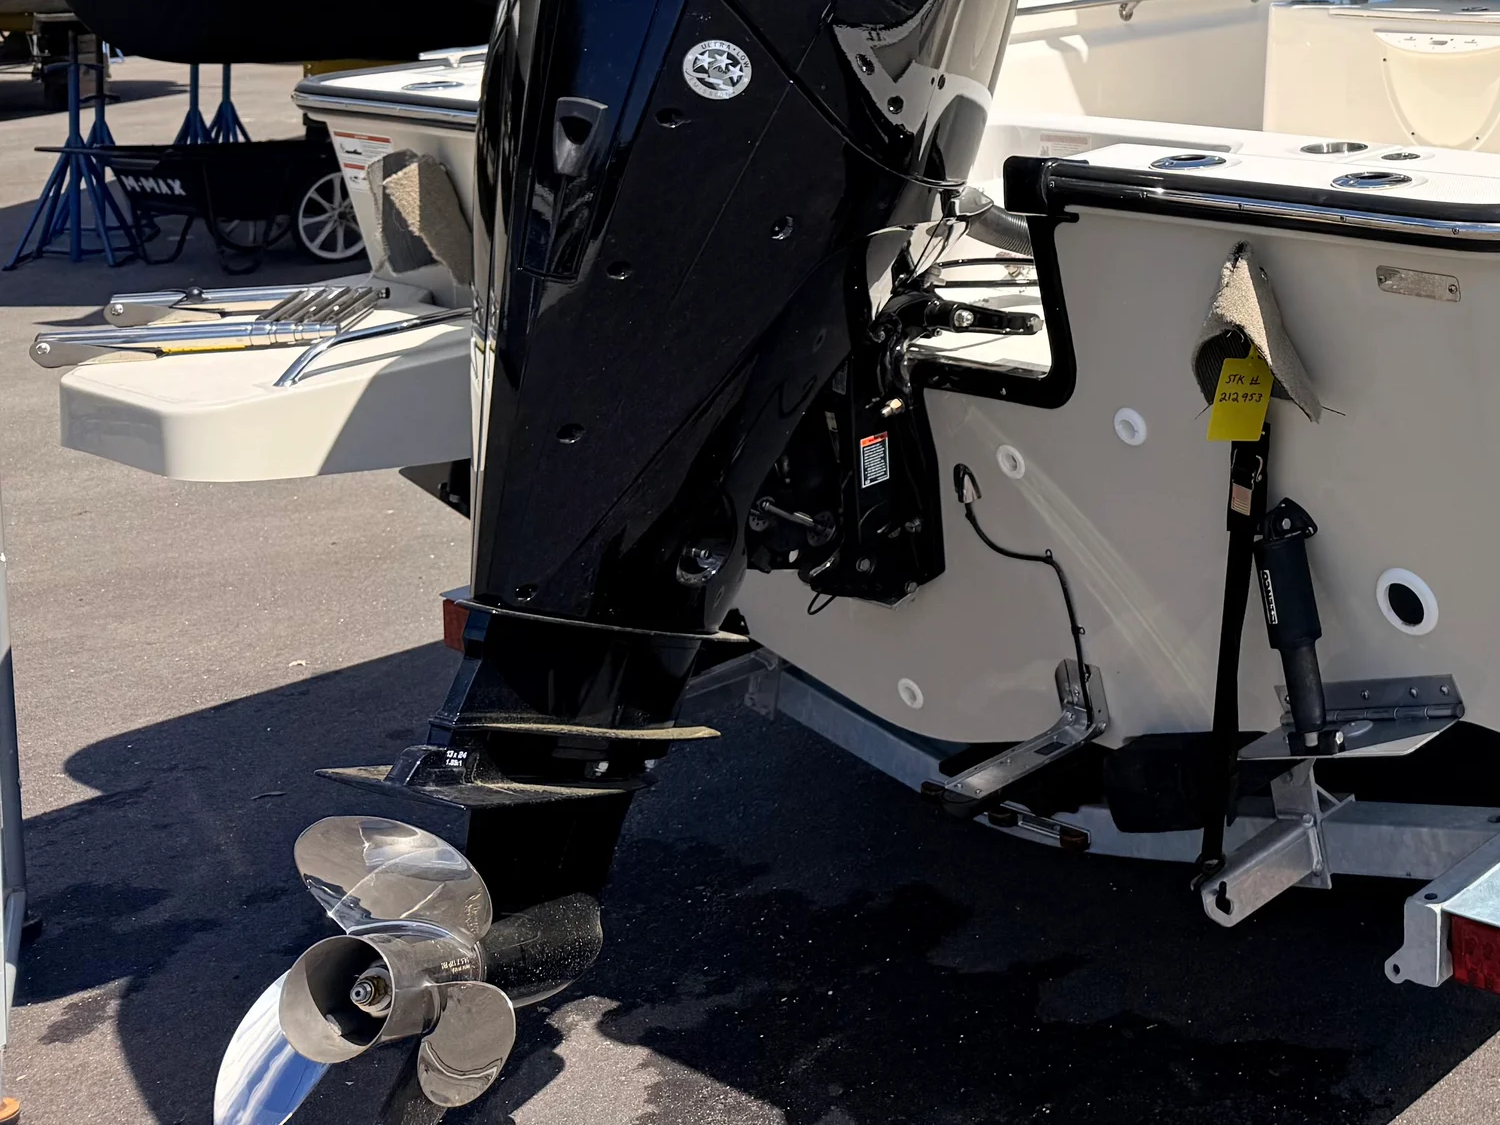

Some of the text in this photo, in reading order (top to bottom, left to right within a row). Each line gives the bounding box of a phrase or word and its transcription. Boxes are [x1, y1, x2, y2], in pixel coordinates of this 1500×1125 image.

[701, 41, 750, 68] ULTRA LOW
[1225, 373, 1245, 385] STK
